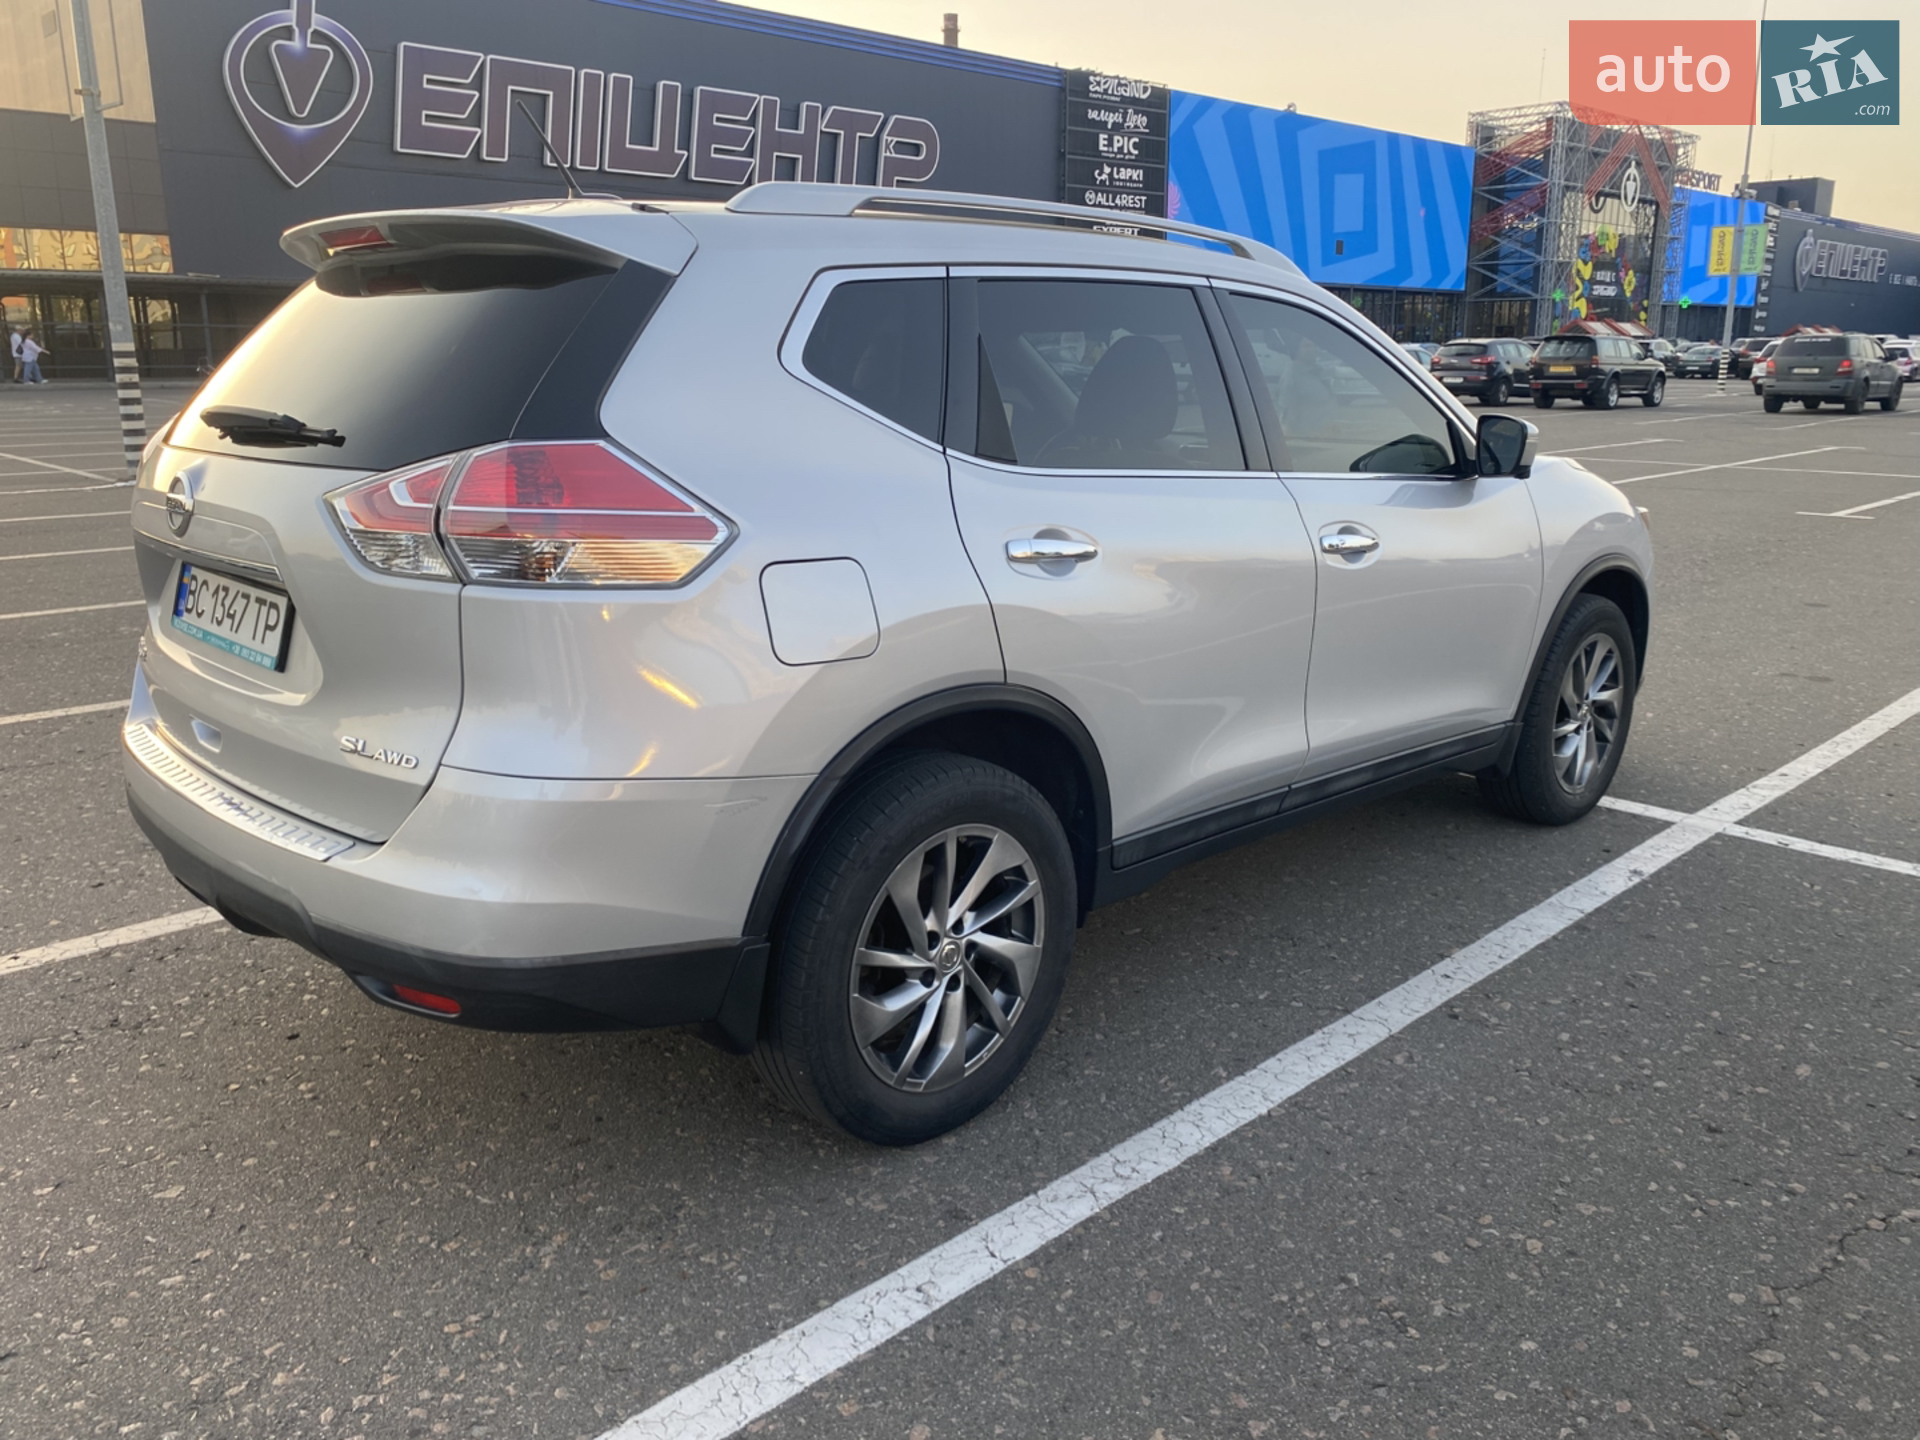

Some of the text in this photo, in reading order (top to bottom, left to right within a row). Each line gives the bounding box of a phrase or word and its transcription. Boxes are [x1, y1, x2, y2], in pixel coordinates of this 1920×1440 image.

[395, 42, 940, 186] ЕПІЦЕНТР
[1098, 133, 1139, 155] E.PIC
[1095, 192, 1147, 208] ALL4REST
[184, 573, 210, 619] BC
[210, 583, 252, 635] 1347
[251, 596, 281, 645] TP
[340, 735, 419, 769] SL AWD
